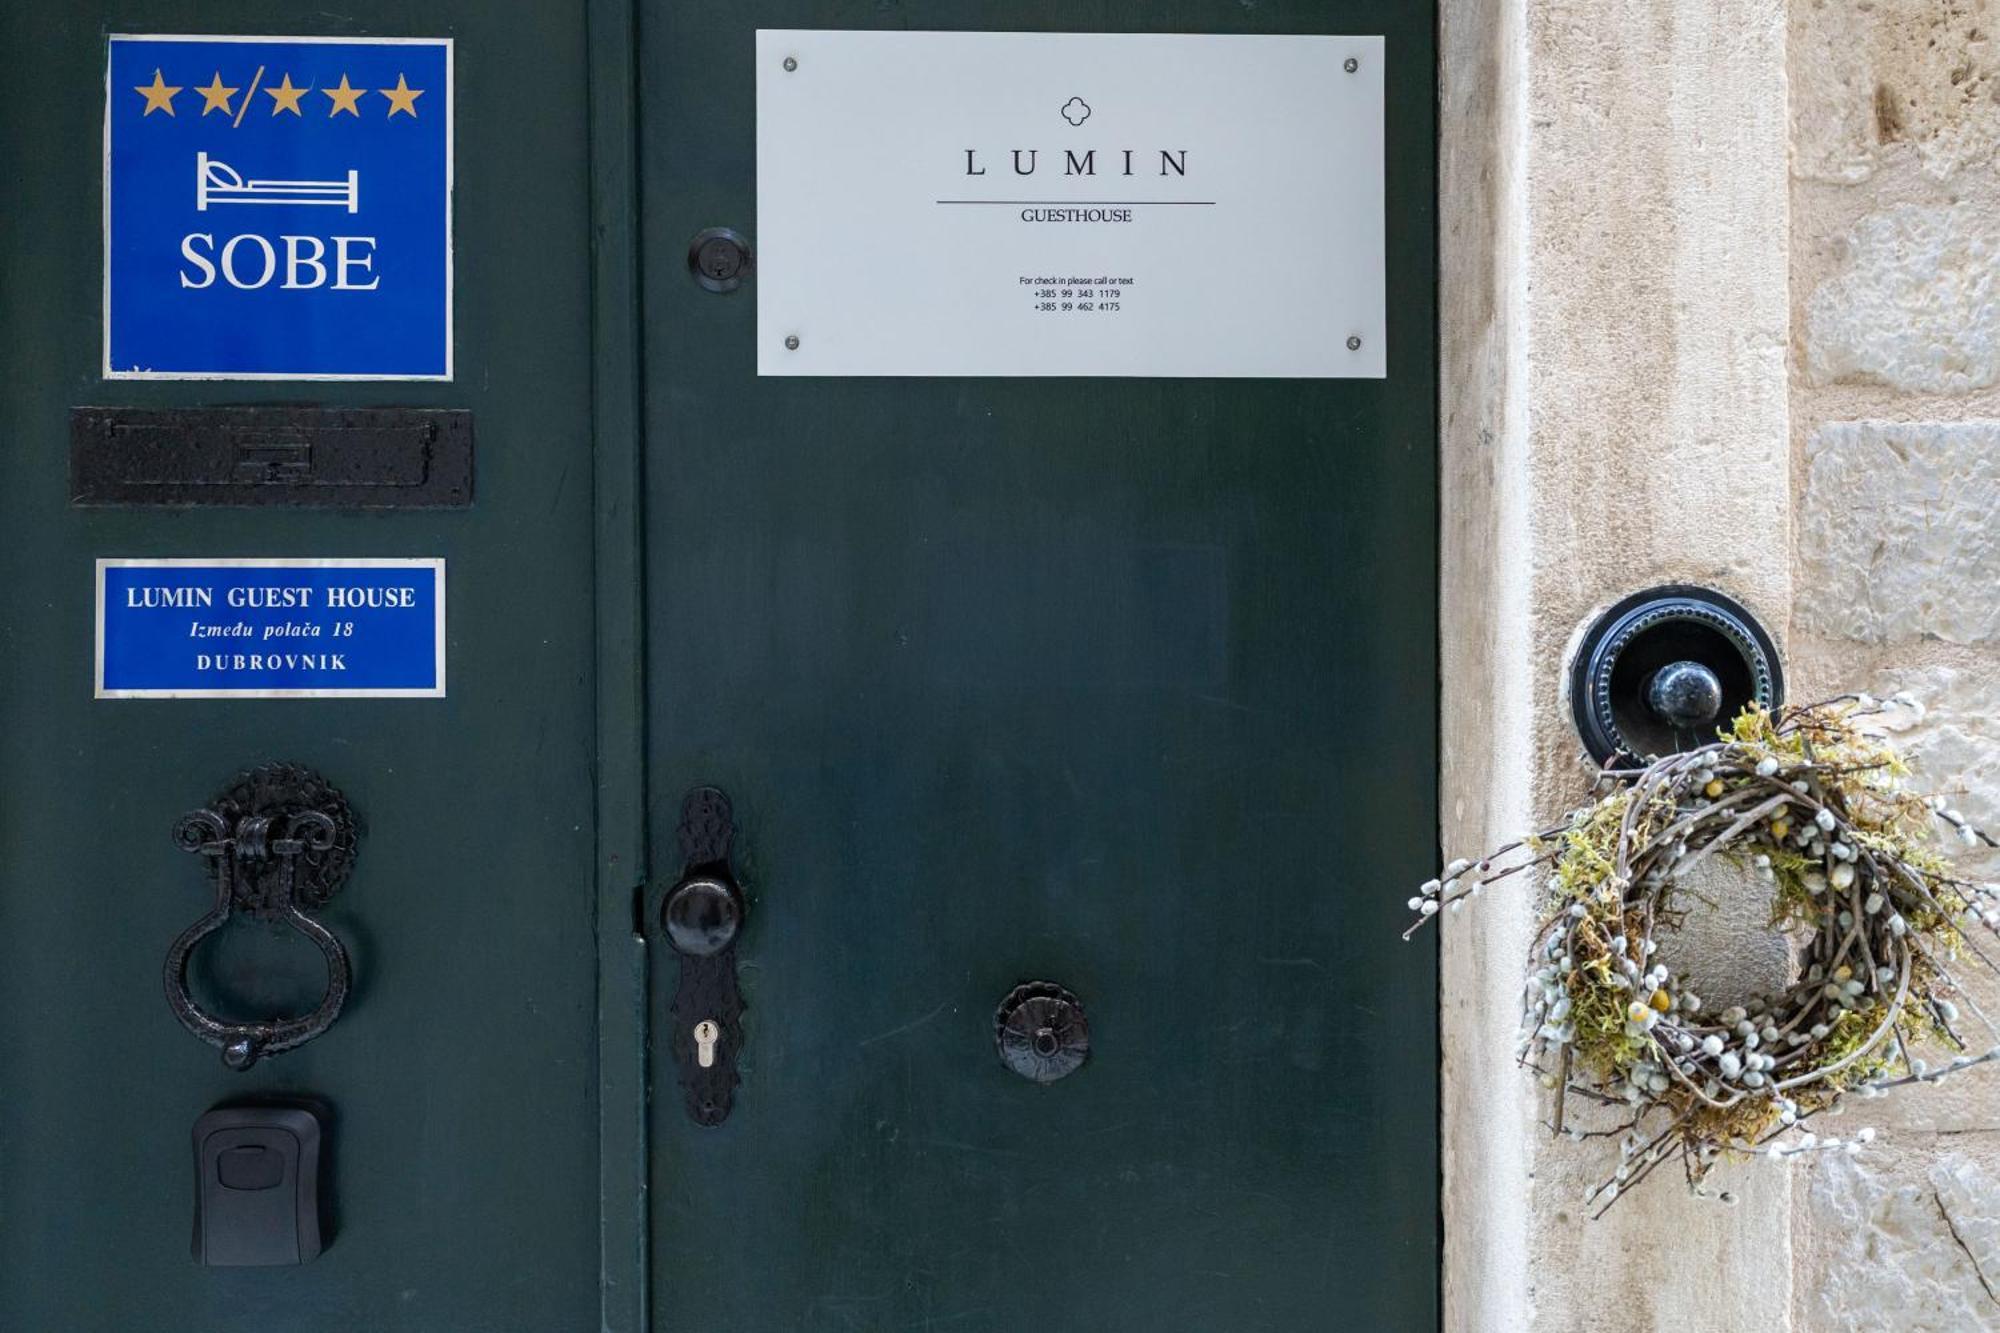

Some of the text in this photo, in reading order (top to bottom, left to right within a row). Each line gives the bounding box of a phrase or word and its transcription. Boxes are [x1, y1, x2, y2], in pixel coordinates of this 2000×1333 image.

[964, 149, 1188, 177] LUMIN
[1020, 208, 1133, 223] GUESTHOUSE
[180, 233, 381, 290] SOBE
[1019, 276, 1134, 287] For check in please call or text
[1034, 288, 1121, 298] +385 99 343 1179
[1034, 301, 1121, 311] +385 99 462 4175
[127, 587, 416, 608] LUMIN GUEST HOUSE
[263, 621, 321, 641] polača
[332, 621, 354, 637] 18
[196, 654, 346, 670] DUBROVNIK
